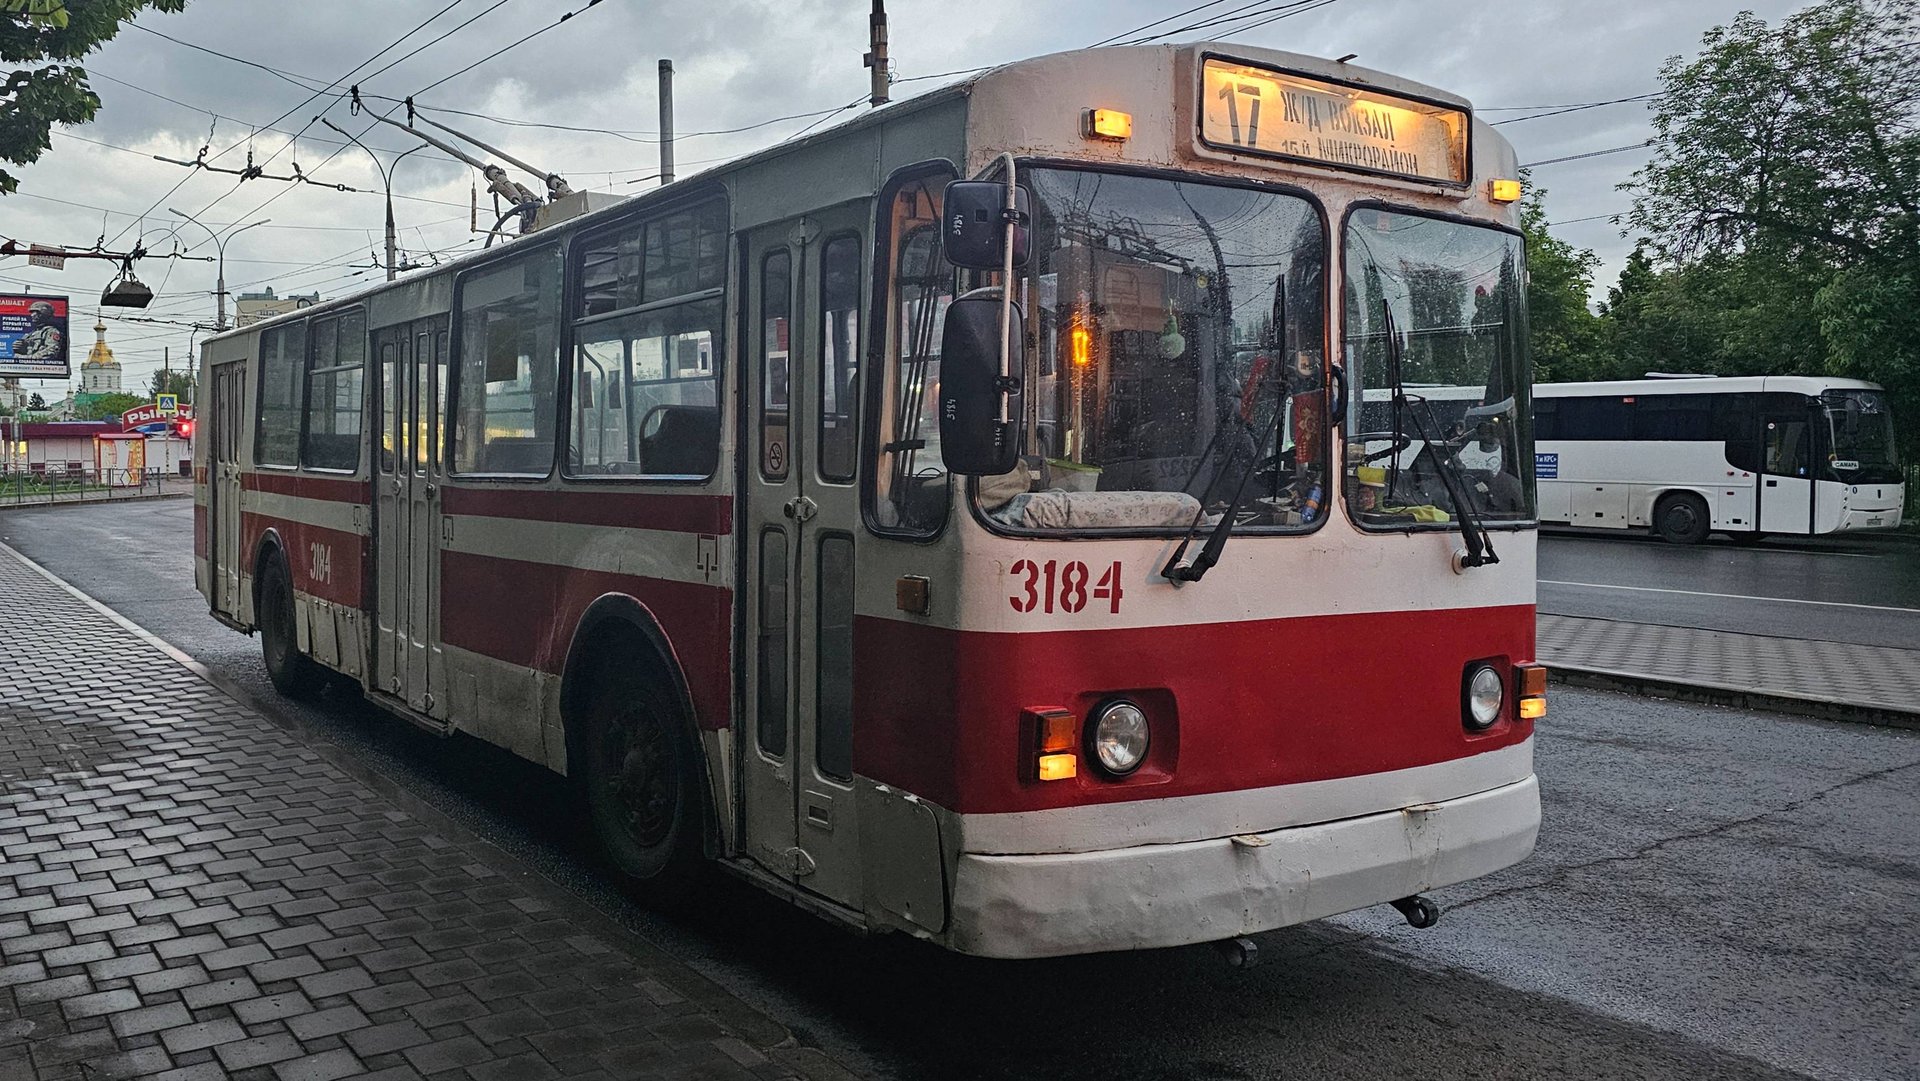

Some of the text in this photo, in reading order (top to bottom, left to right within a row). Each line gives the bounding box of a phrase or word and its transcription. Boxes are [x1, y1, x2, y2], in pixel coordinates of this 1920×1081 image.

[1218, 81, 1261, 148] 17
[1279, 90, 1395, 142] Ж/Д ВОКЗАЛ
[1317, 137, 1419, 176] МИКРОРАЙОН
[946, 399, 956, 420] 3184
[310, 542, 331, 585] 3184
[1010, 559, 1123, 614] 3184
